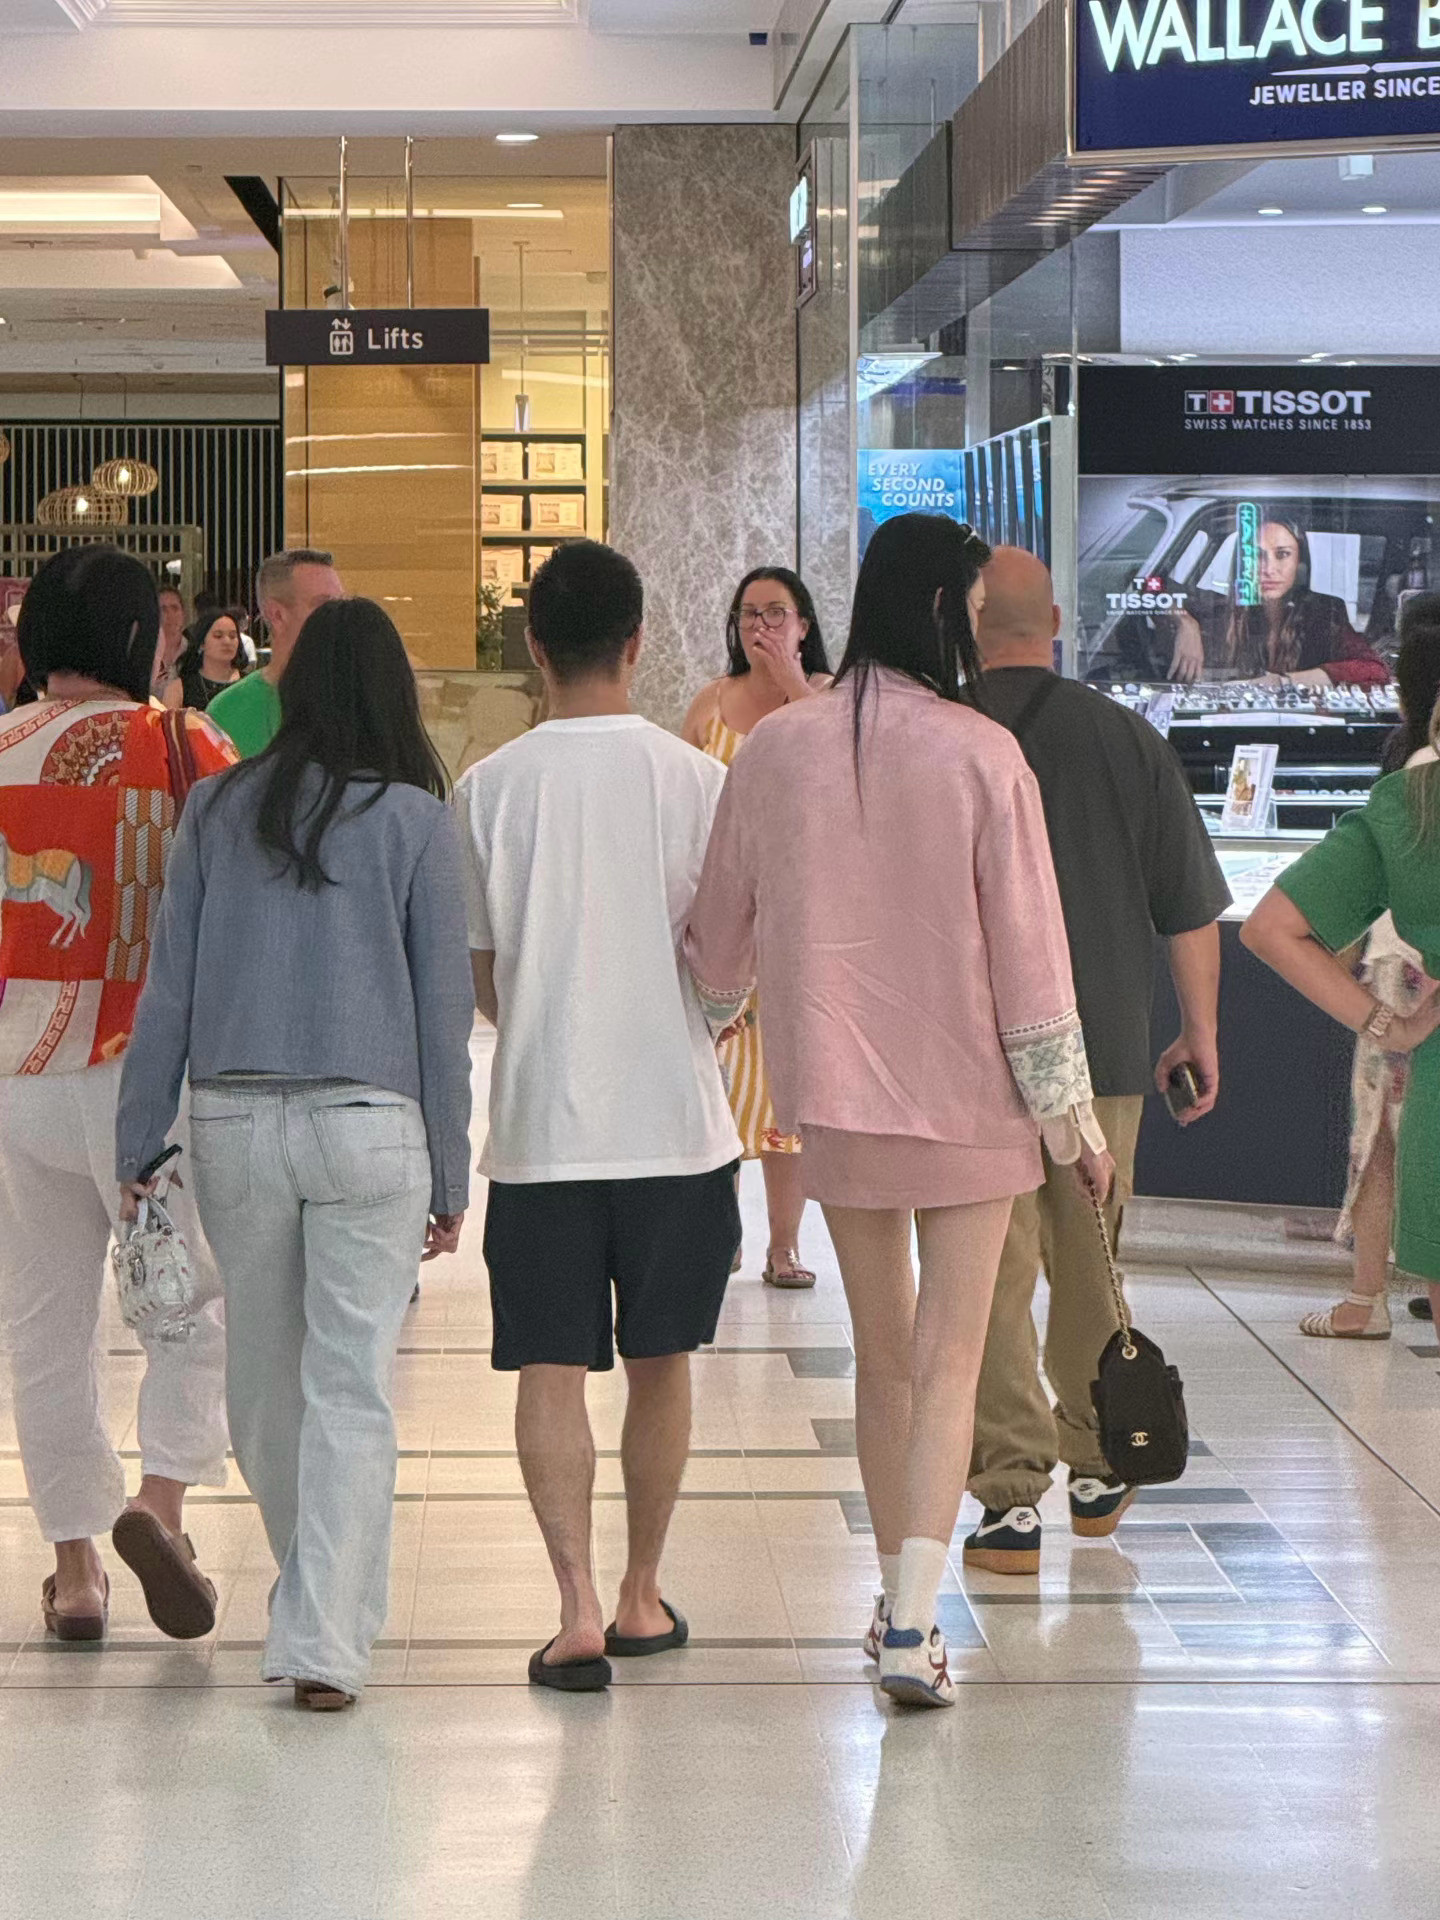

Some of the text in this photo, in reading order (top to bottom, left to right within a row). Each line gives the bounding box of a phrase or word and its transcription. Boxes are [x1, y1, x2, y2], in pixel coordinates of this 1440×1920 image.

[1089, 0, 1384, 72] WALLACE
[1250, 76, 1440, 105] JEWELLER SINCE
[367, 327, 424, 350] Lifts
[1236, 390, 1371, 415] TISSOT
[1184, 419, 1371, 430] SWISS WATCHES SINCE 1853
[868, 463, 921, 476] EVERY
[872, 478, 945, 491] SECOND
[882, 493, 955, 506] COUNTS
[1105, 593, 1188, 609] TISSOT
